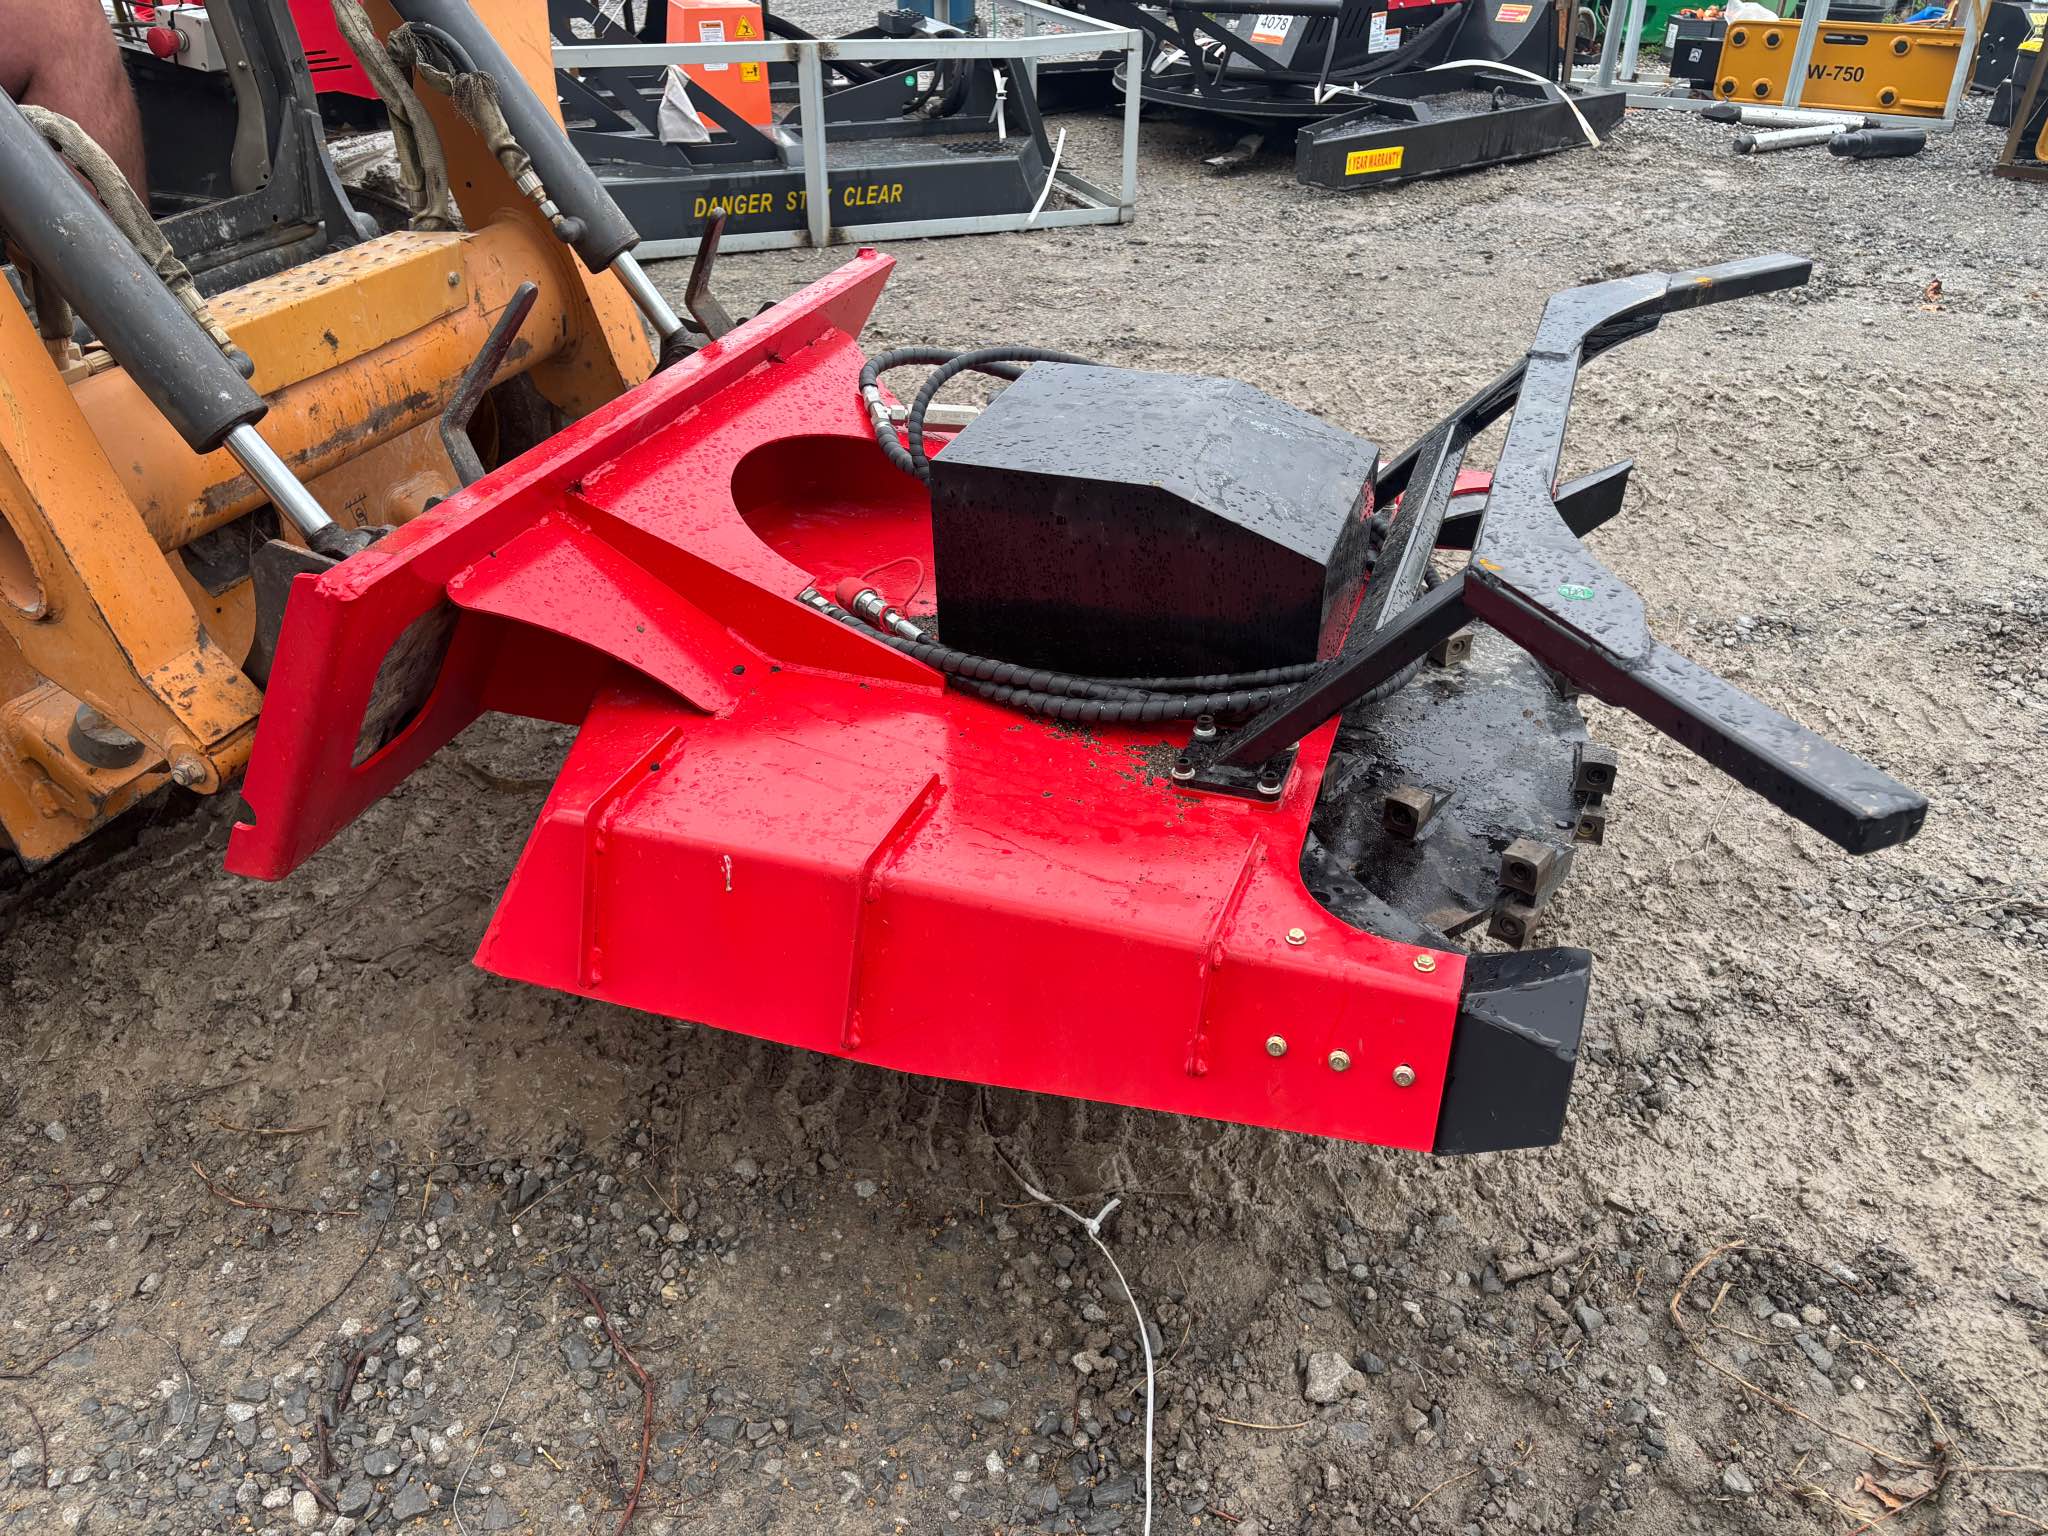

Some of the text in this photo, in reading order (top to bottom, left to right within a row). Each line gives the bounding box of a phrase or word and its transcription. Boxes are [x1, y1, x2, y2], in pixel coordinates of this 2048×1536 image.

[1261, 15, 1289, 30] 4078
[694, 183, 903, 217] DANGER ST CLEAR
